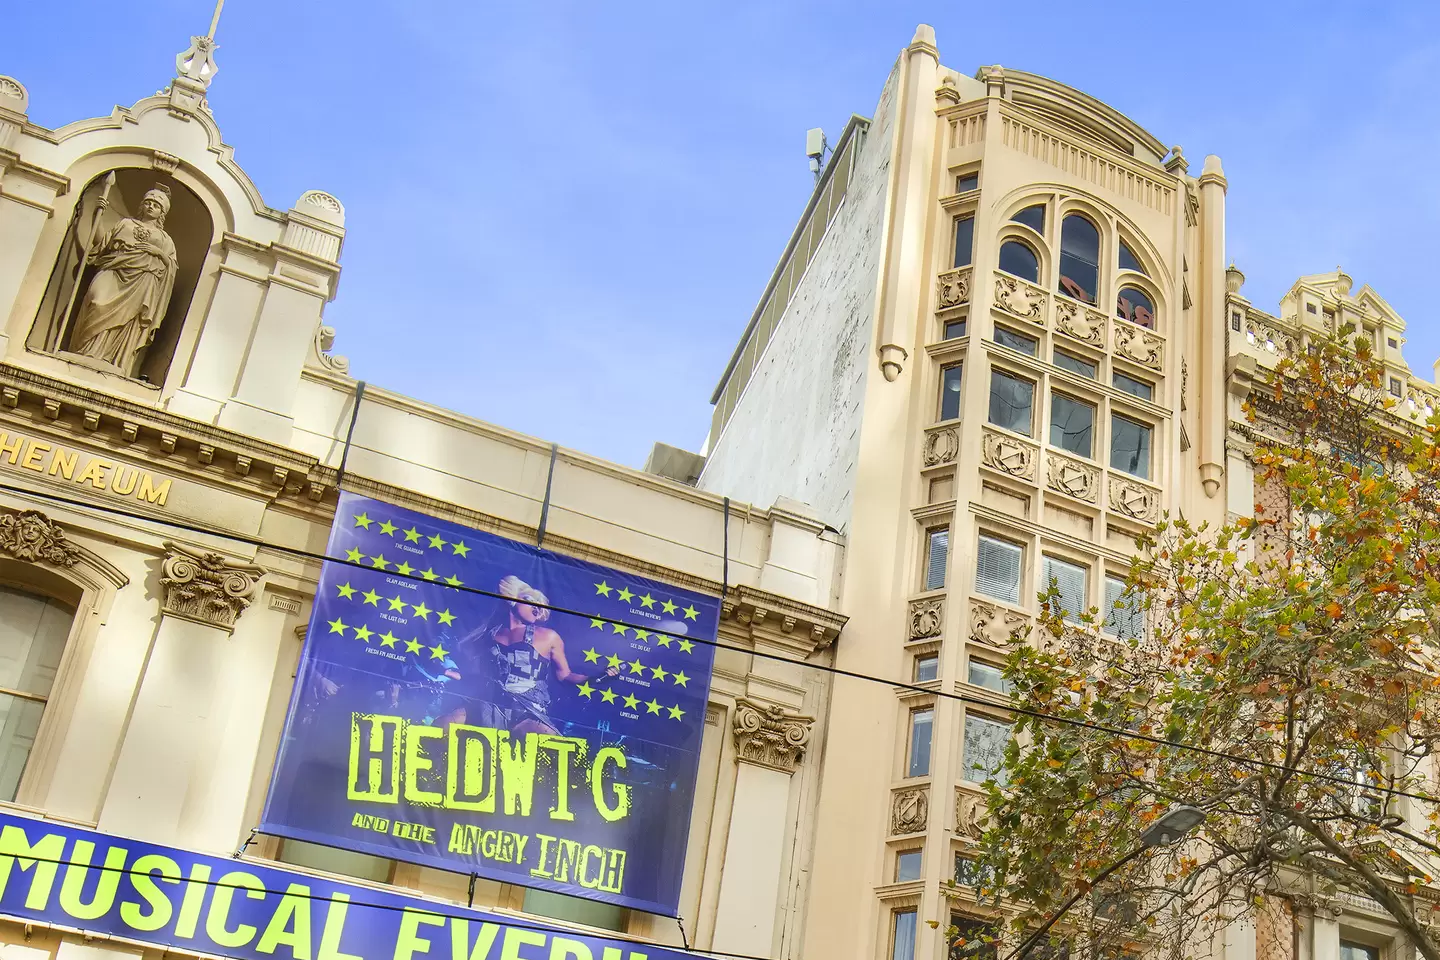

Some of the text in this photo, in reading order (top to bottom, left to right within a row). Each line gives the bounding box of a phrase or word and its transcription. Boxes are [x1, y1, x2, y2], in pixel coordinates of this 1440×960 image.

[379, 612, 388, 620] THE
[645, 612, 661, 620] REVIEWS
[365, 647, 380, 656] FRESH
[347, 712, 632, 822] HEDWIG
[351, 812, 627, 894] AND THE ANGRY INCH
